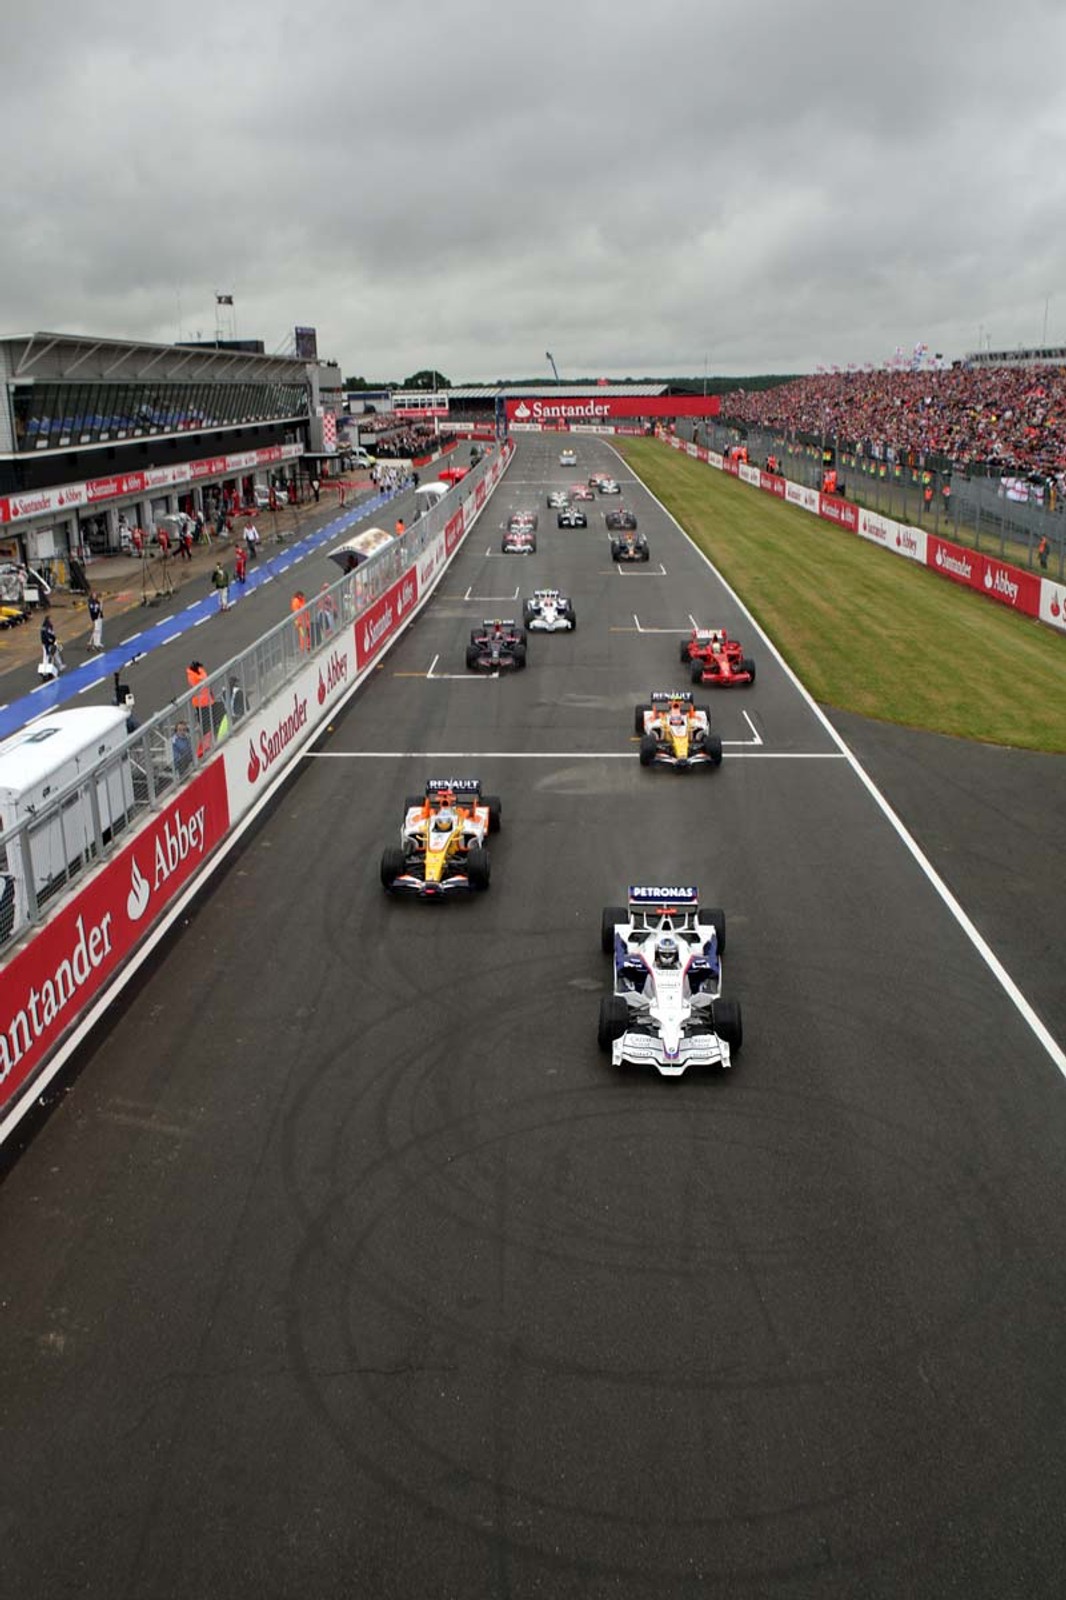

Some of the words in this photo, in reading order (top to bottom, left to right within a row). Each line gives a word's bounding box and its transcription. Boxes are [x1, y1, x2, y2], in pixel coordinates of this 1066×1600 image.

[533, 400, 610, 418] Santander
[942, 548, 972, 579] Santander
[993, 569, 1019, 605] Abbey
[260, 693, 308, 772] Santander
[326, 650, 348, 694] Abbey
[430, 780, 479, 789] RENAULT
[153, 805, 205, 892] Abbey
[633, 887, 693, 897] PETRONAS
